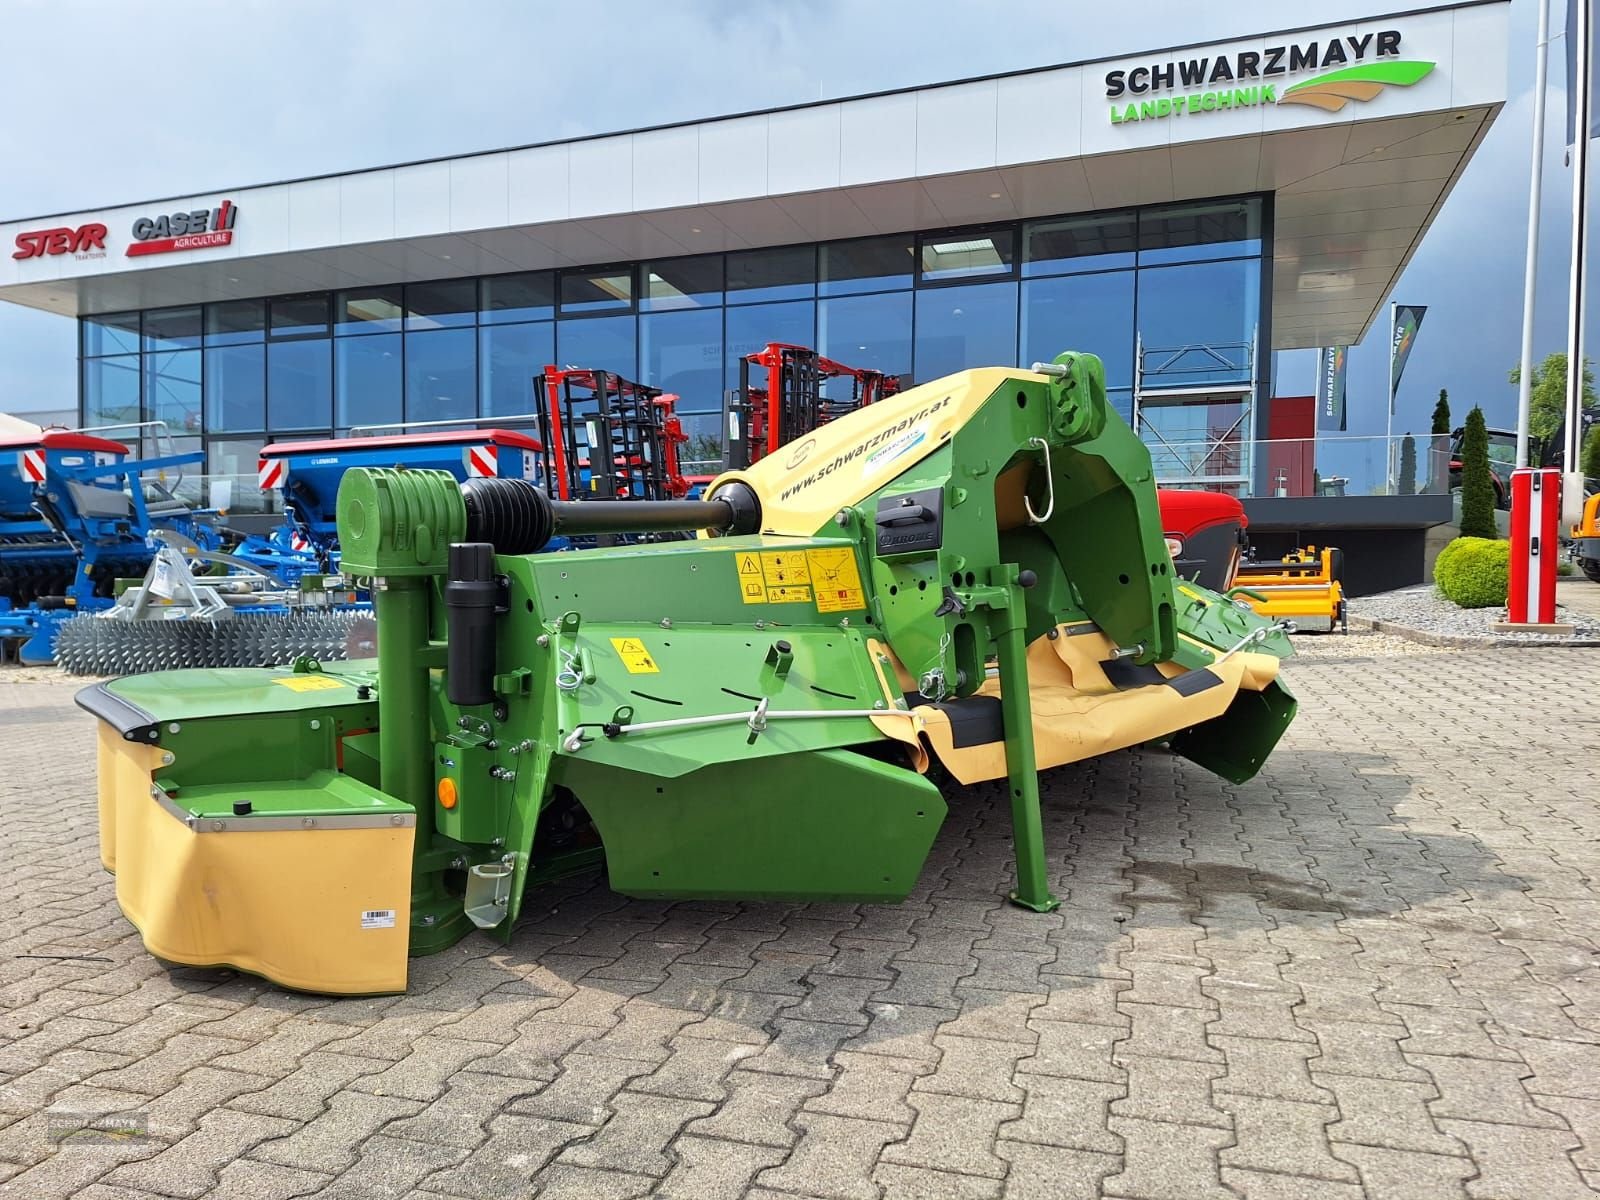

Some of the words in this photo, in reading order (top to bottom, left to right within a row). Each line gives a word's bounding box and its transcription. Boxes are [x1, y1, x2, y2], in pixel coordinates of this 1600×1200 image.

[1104, 30, 1402, 98] SCHWARZMAYR
[1110, 84, 1277, 125] LANDTECHNIK
[12, 222, 108, 260] STEYR
[132, 209, 209, 241] CASE
[173, 232, 227, 249] AGRICULTURE
[780, 396, 952, 502] www.schwarzmayr.at
